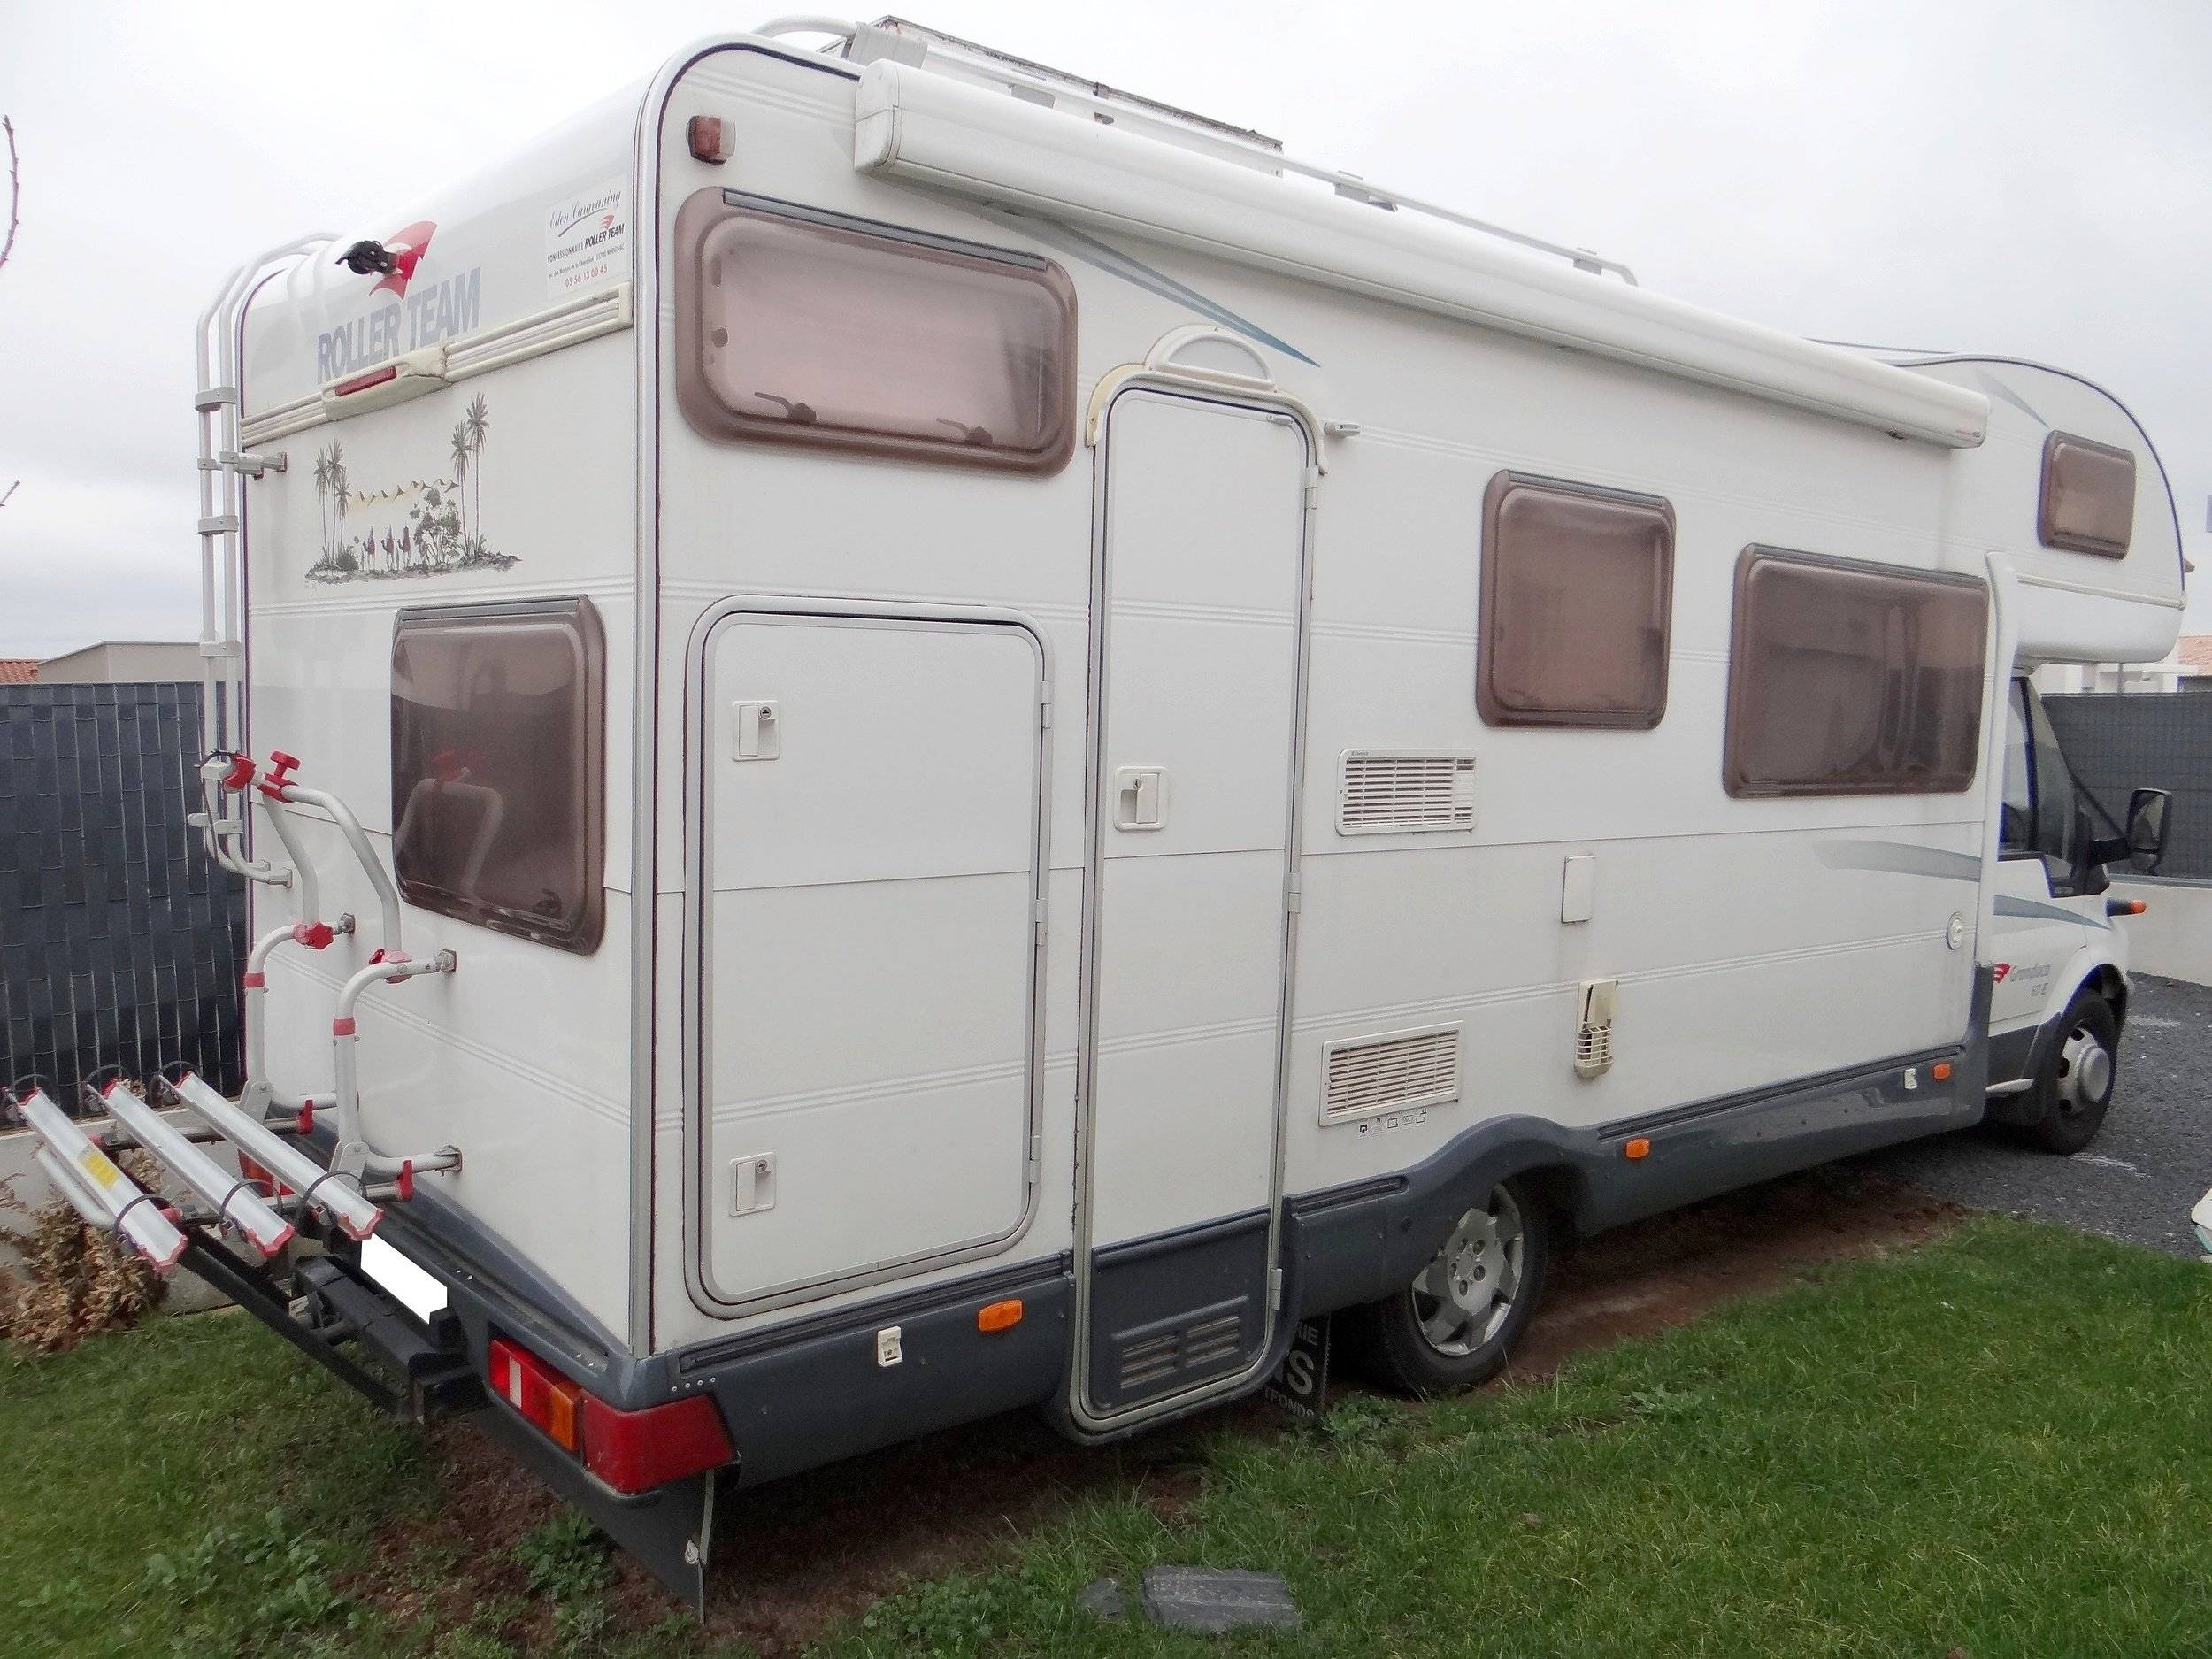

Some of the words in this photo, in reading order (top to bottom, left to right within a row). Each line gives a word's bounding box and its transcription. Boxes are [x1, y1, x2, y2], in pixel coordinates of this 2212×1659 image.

[549, 211, 569, 228] Eden
[584, 230, 607, 249] ROLLER
[608, 223, 625, 240] TEAM
[317, 302, 402, 385] ROLLER
[407, 265, 481, 352] TEAM
